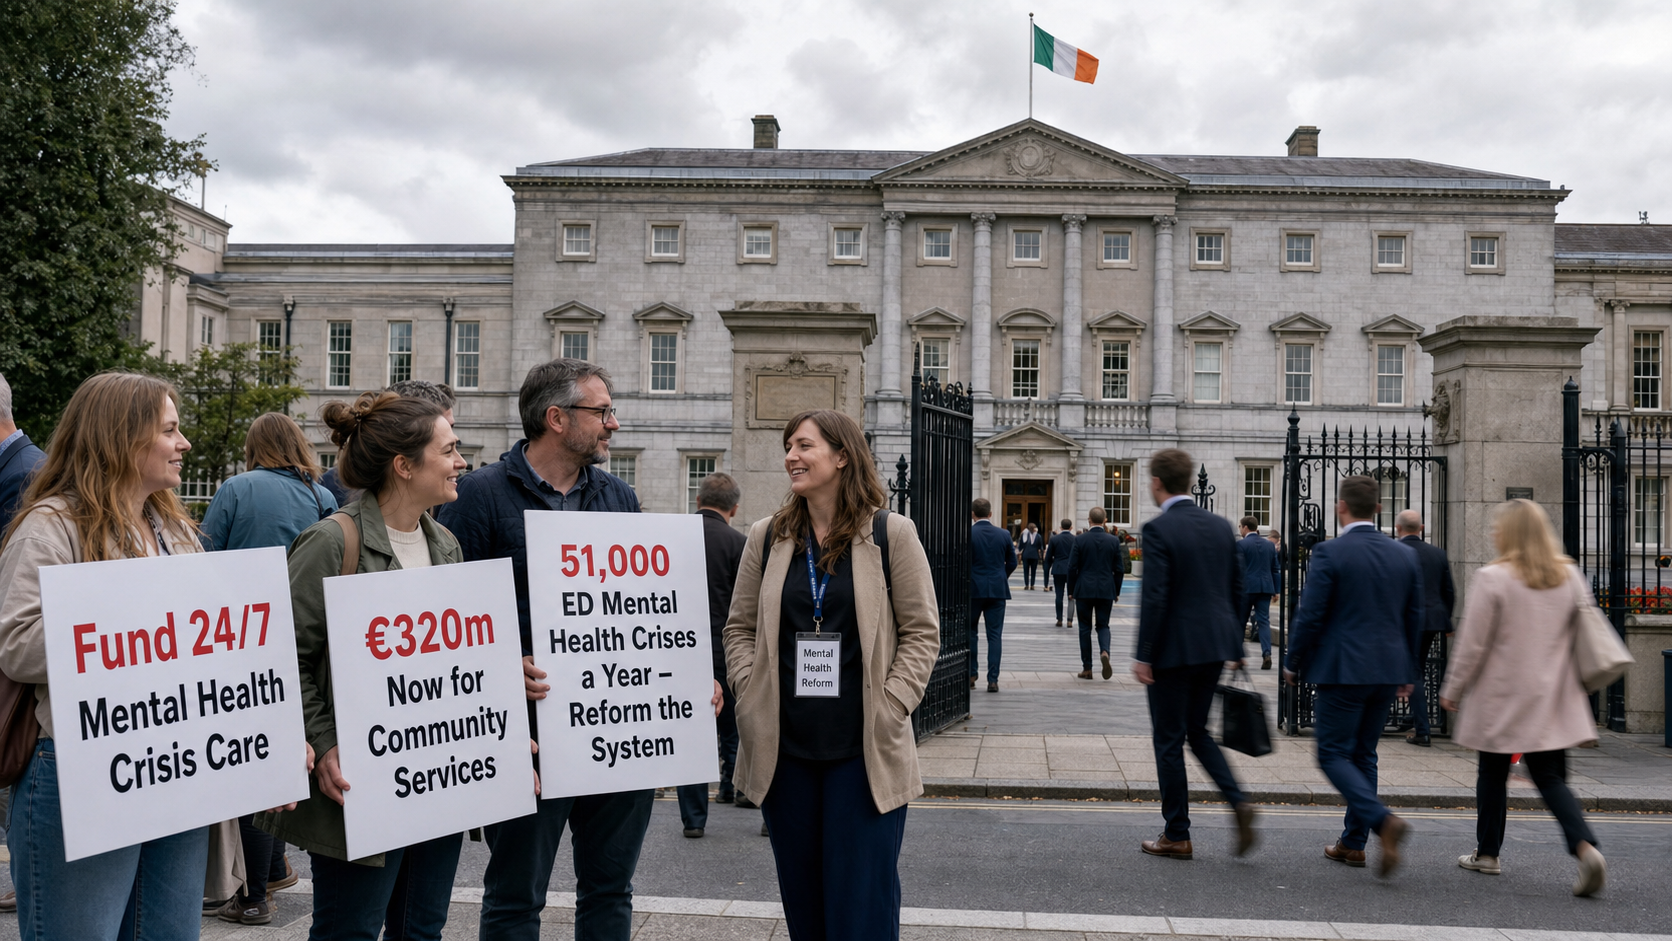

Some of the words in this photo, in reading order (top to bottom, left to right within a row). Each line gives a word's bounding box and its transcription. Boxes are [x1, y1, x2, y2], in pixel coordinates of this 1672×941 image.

[560, 544, 670, 584] 51,000
[562, 591, 594, 617] ED
[602, 590, 678, 616] Mental
[73, 612, 179, 674] Fund
[189, 602, 271, 657] 24/7
[365, 608, 495, 660] €320m
[549, 626, 625, 654] Health
[631, 625, 697, 651] Crises
[803, 648, 834, 658] Mental
[803, 663, 832, 673] Health
[386, 674, 443, 707] Now
[450, 665, 484, 697] for
[581, 670, 595, 690] a
[601, 662, 652, 688] Year
[801, 677, 833, 688] Reform
[78, 684, 188, 741] Mental
[197, 668, 285, 718] Health
[569, 698, 652, 728] Reform
[658, 695, 693, 721] the
[368, 705, 508, 757] Community
[109, 741, 198, 794] Crisis
[205, 732, 270, 771] Care
[591, 735, 675, 768] System
[394, 755, 497, 799] Services
